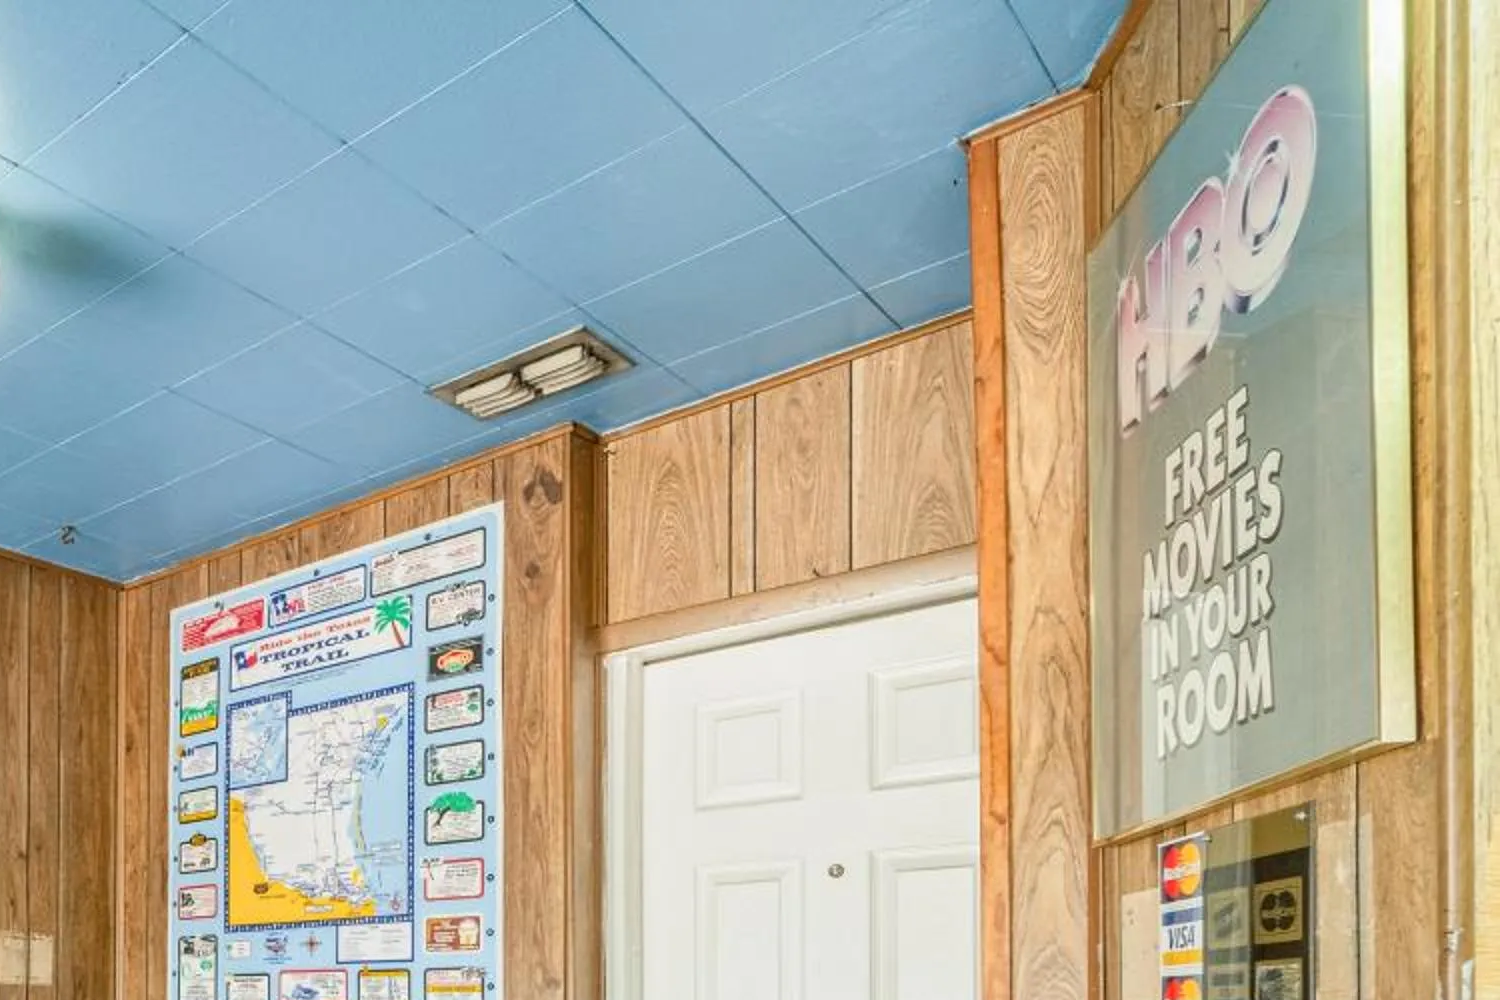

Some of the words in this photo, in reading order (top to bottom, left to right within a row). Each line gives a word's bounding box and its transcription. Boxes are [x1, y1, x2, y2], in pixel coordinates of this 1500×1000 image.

[1117, 84, 1317, 437] HBO
[1164, 384, 1250, 530] FREE
[1142, 447, 1284, 621] MOVIES
[259, 629, 371, 664] TROPICAL
[280, 651, 350, 673] TRAIL
[1149, 613, 1179, 682] IN
[1182, 552, 1274, 657] YOUR
[1155, 626, 1276, 760] ROOM
[1167, 925, 1196, 950] VISA
